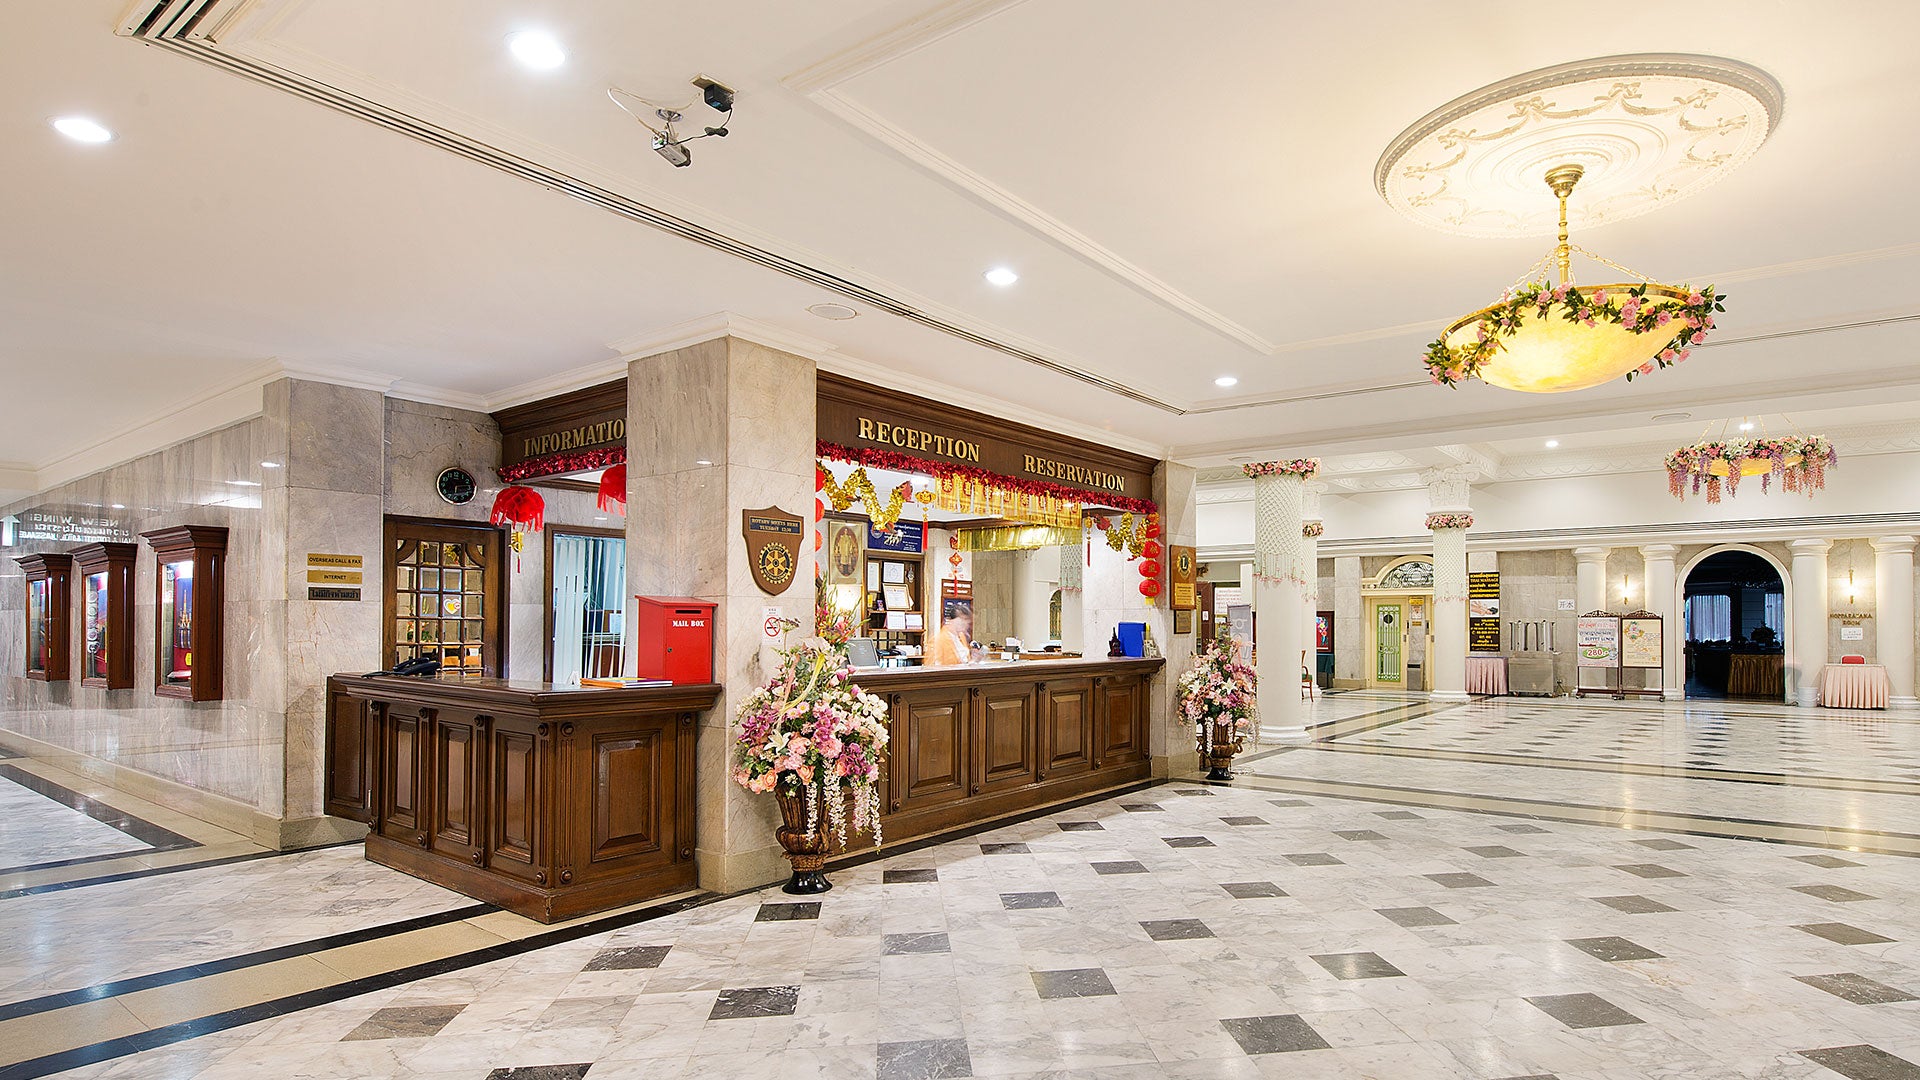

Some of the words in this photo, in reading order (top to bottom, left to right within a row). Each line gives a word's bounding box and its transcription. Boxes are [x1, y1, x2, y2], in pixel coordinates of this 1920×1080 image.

[524, 418, 627, 457] INFORMATIO
[858, 417, 980, 463] RECEPTION
[1024, 454, 1126, 492] RESERVATION
[1558, 600, 1574, 608] 开水
